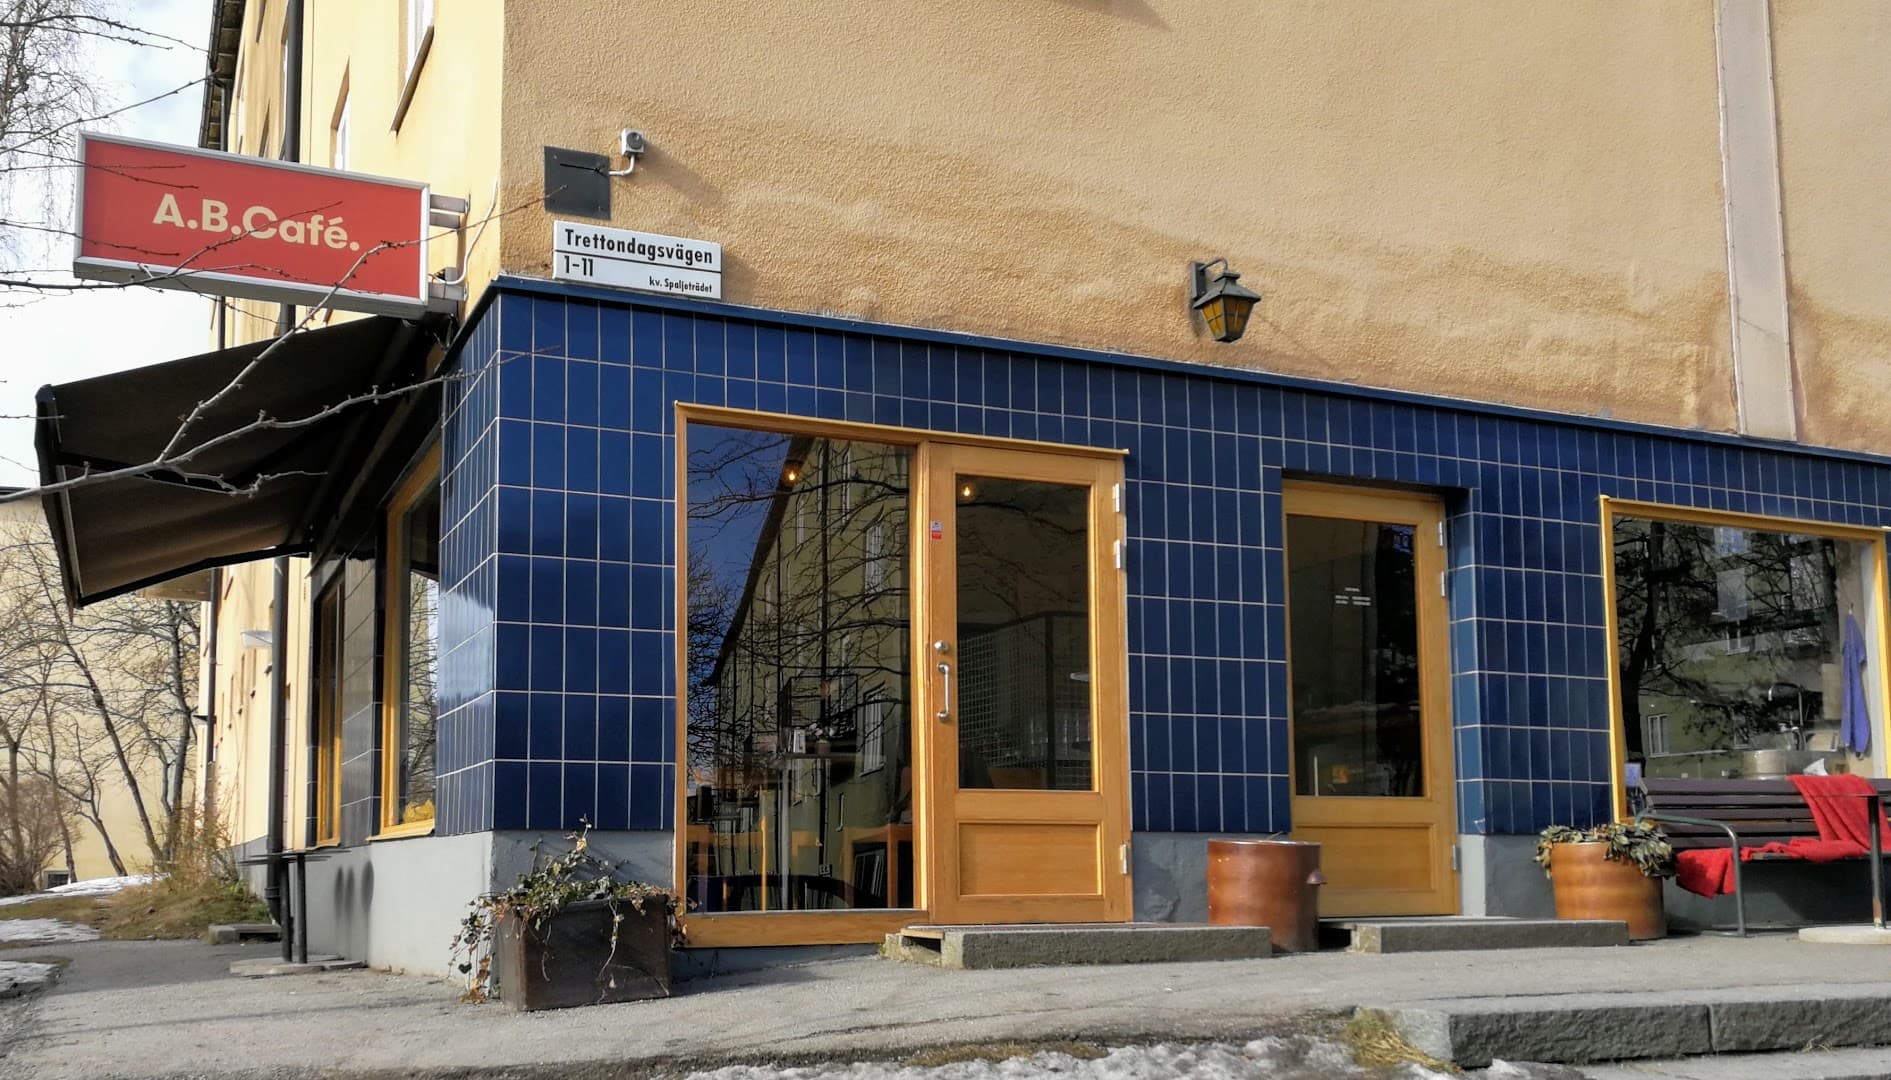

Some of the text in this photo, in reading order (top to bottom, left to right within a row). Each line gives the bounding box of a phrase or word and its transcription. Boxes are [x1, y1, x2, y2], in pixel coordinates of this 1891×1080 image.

[152, 193, 360, 252] A.B.Café.
[565, 229, 712, 265] Trettondagsvägen
[564, 256, 594, 276] 1-11
[649, 276, 662, 288] kv.
